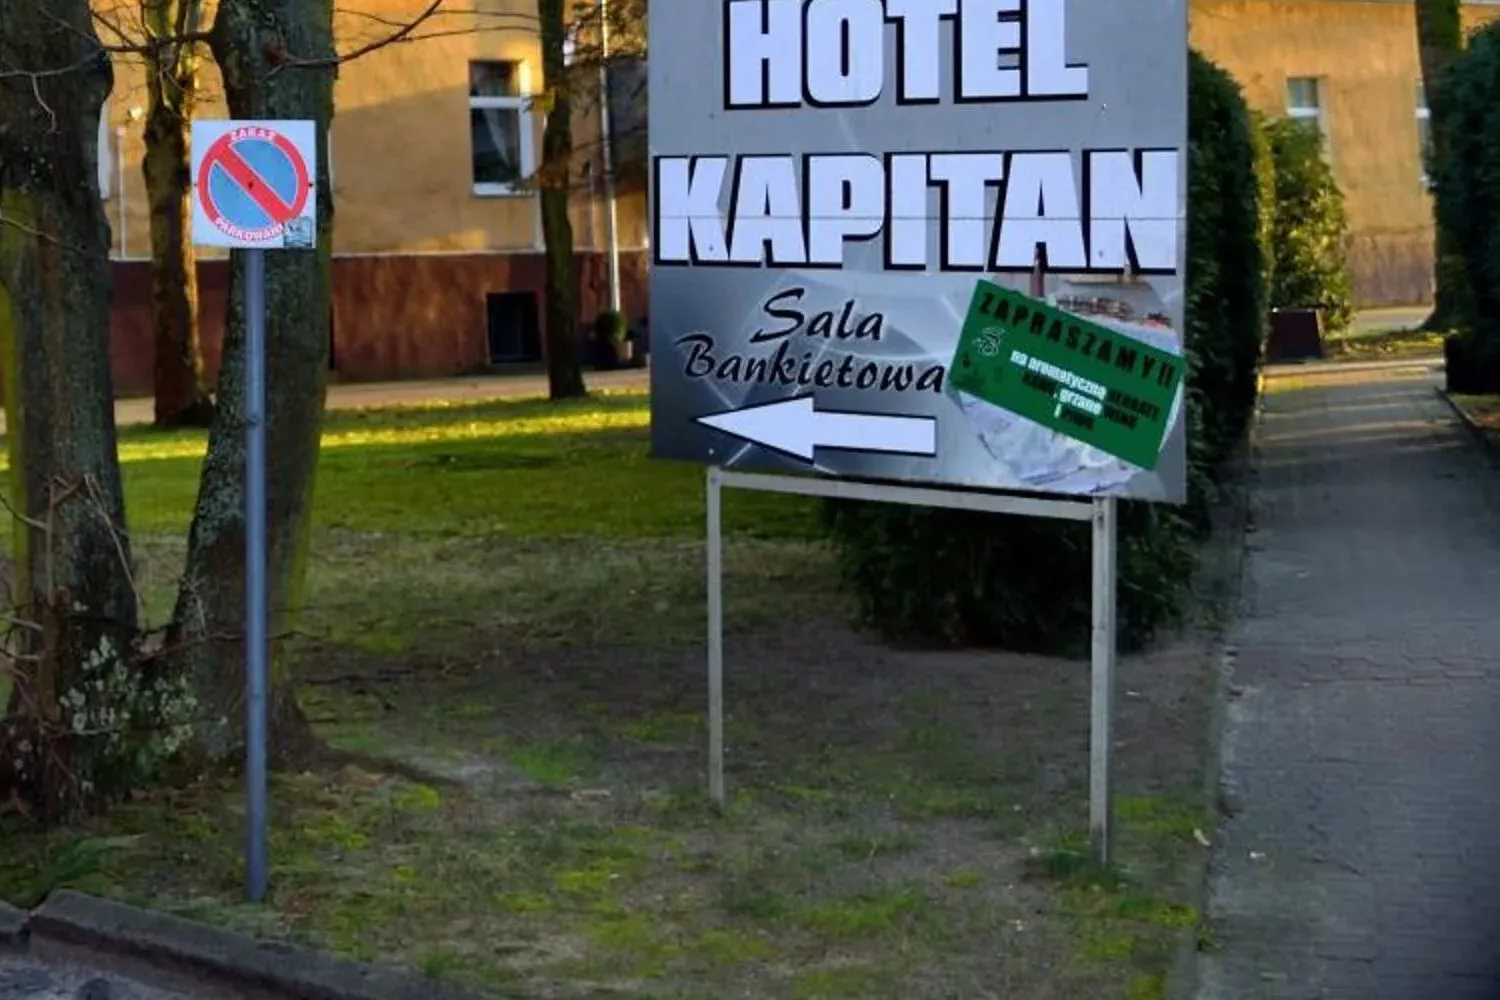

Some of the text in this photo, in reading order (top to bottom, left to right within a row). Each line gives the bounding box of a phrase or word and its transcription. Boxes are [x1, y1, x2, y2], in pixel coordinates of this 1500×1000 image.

[653, 148, 1178, 275] KAPITAN
[750, 288, 883, 342] Sala
[676, 334, 945, 393] Bankietowa
